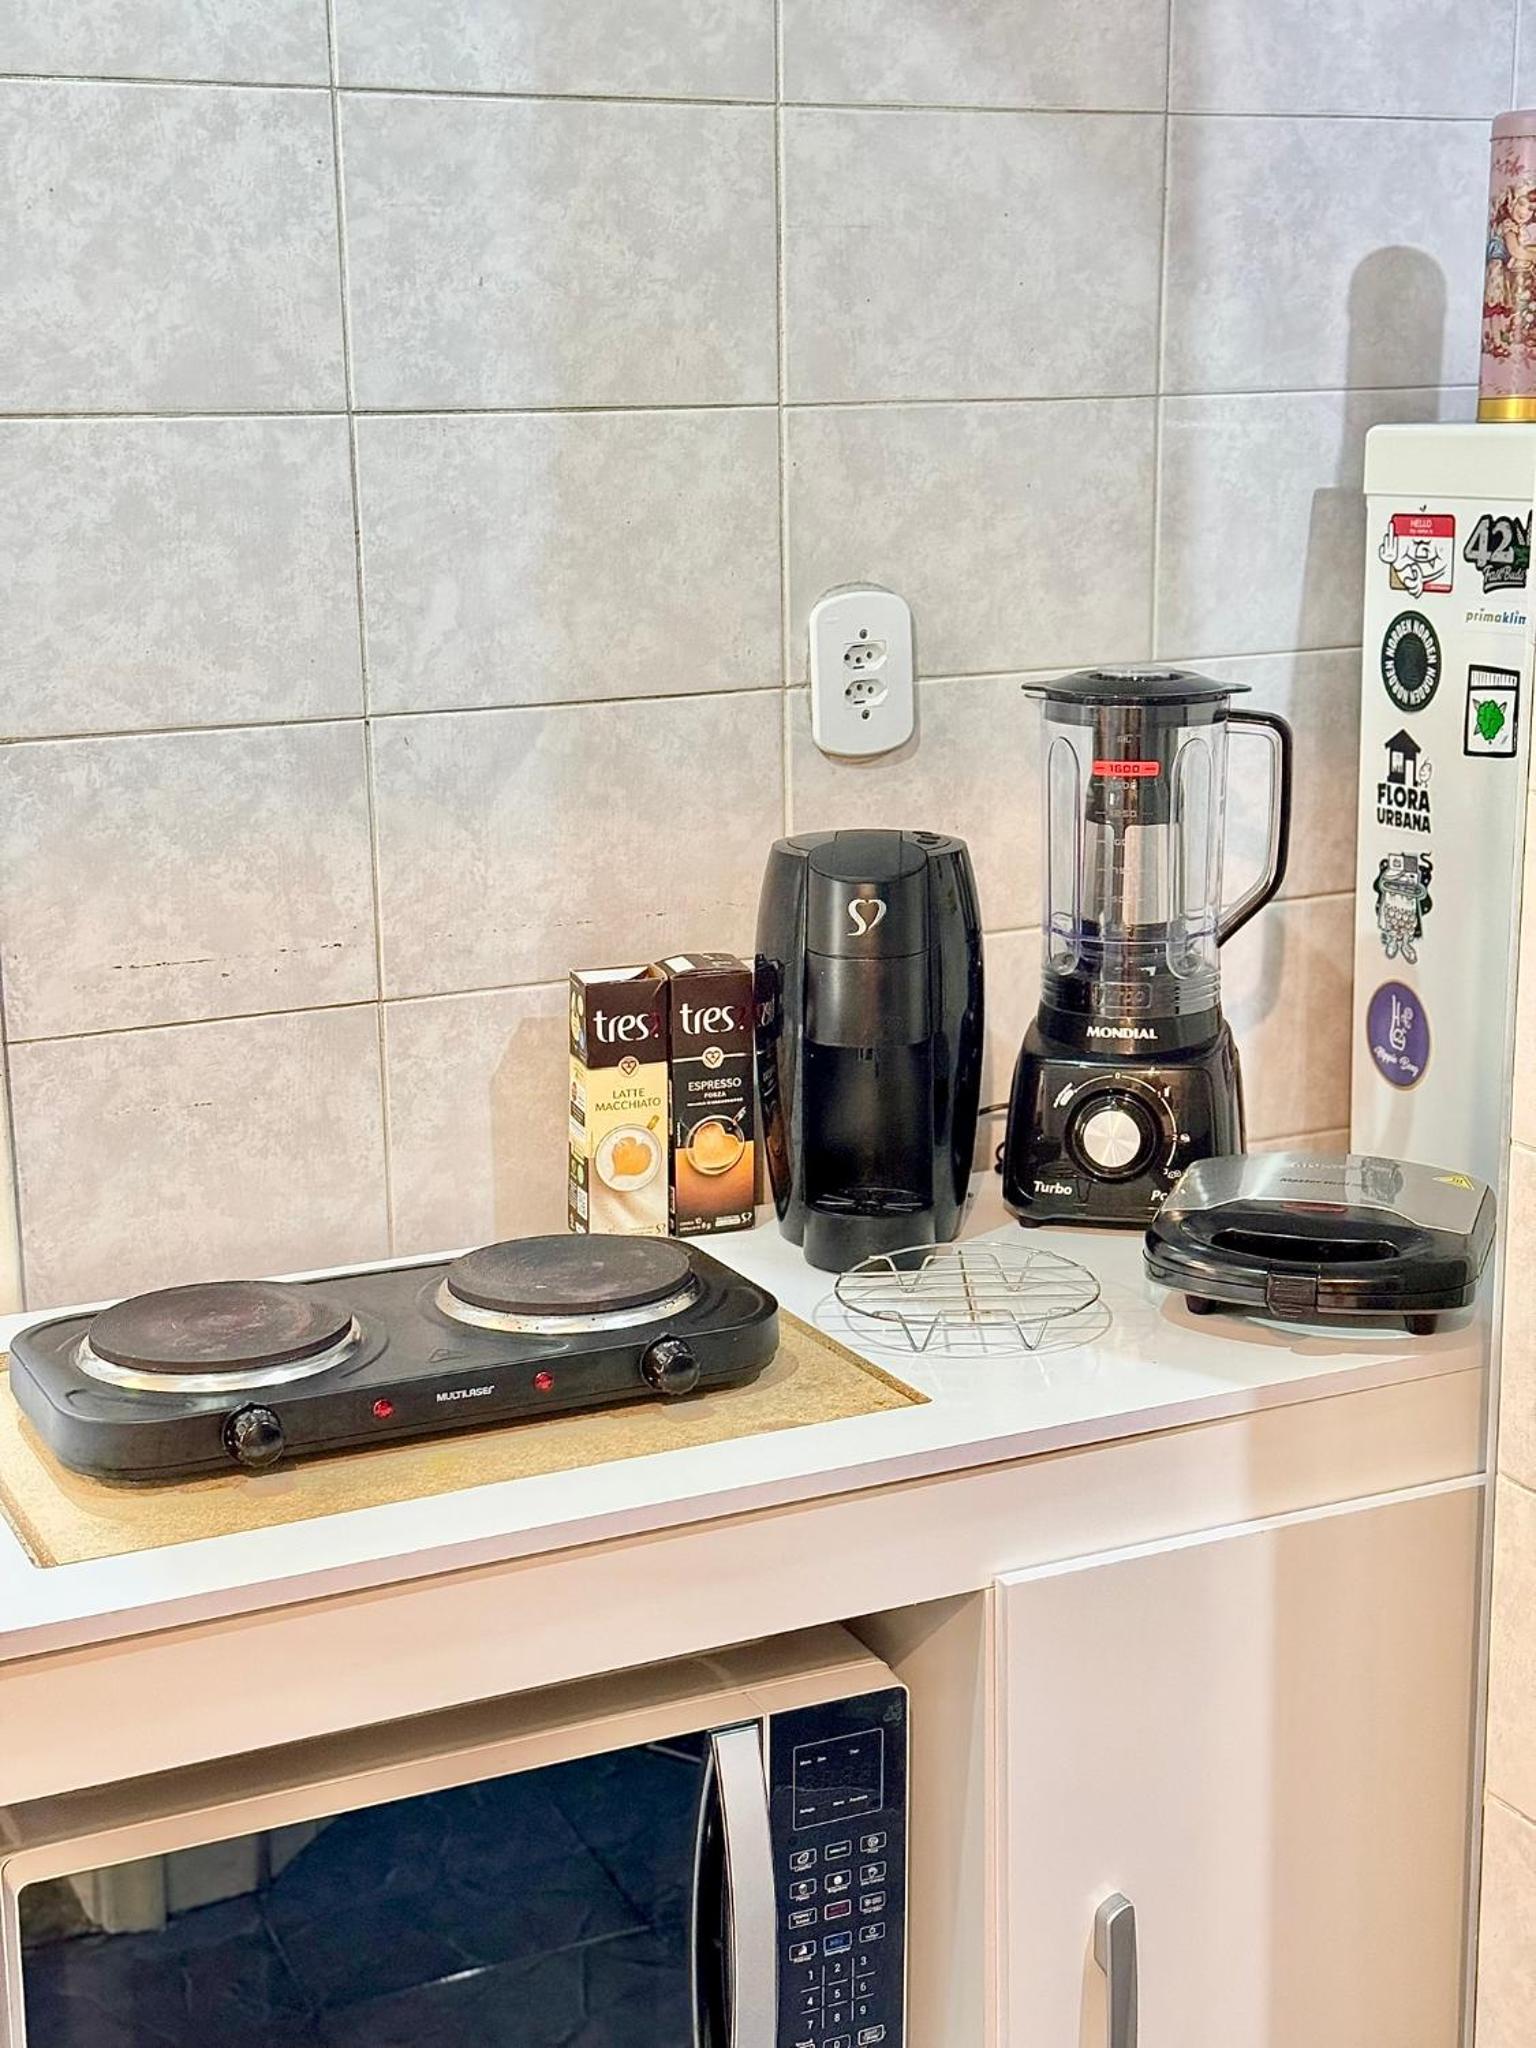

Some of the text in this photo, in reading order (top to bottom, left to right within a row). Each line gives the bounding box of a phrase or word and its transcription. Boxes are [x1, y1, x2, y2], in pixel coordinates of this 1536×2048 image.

[1410, 519, 1432, 528] HELLO
[1465, 608, 1527, 625] primaklin
[1377, 783, 1431, 813] FLORA
[1377, 807, 1431, 833] URBANA
[1086, 1026, 1158, 1041] MONDIAL
[688, 1077, 742, 1092] ESPRESSO
[612, 1088, 645, 1100] LATTE
[595, 1098, 661, 1112] MACCHIATO
[1033, 1180, 1073, 1196] Turbo
[860, 1956, 867, 1966] 3
[834, 1963, 841, 1973] 2
[808, 1970, 813, 1981] 1
[860, 1982, 867, 1991] 6
[834, 1989, 841, 1998] 5
[807, 1997, 813, 2005] 4
[860, 2005, 866, 2015] 9
[834, 2013, 840, 2022] 8
[808, 2020, 813, 2029] 7
